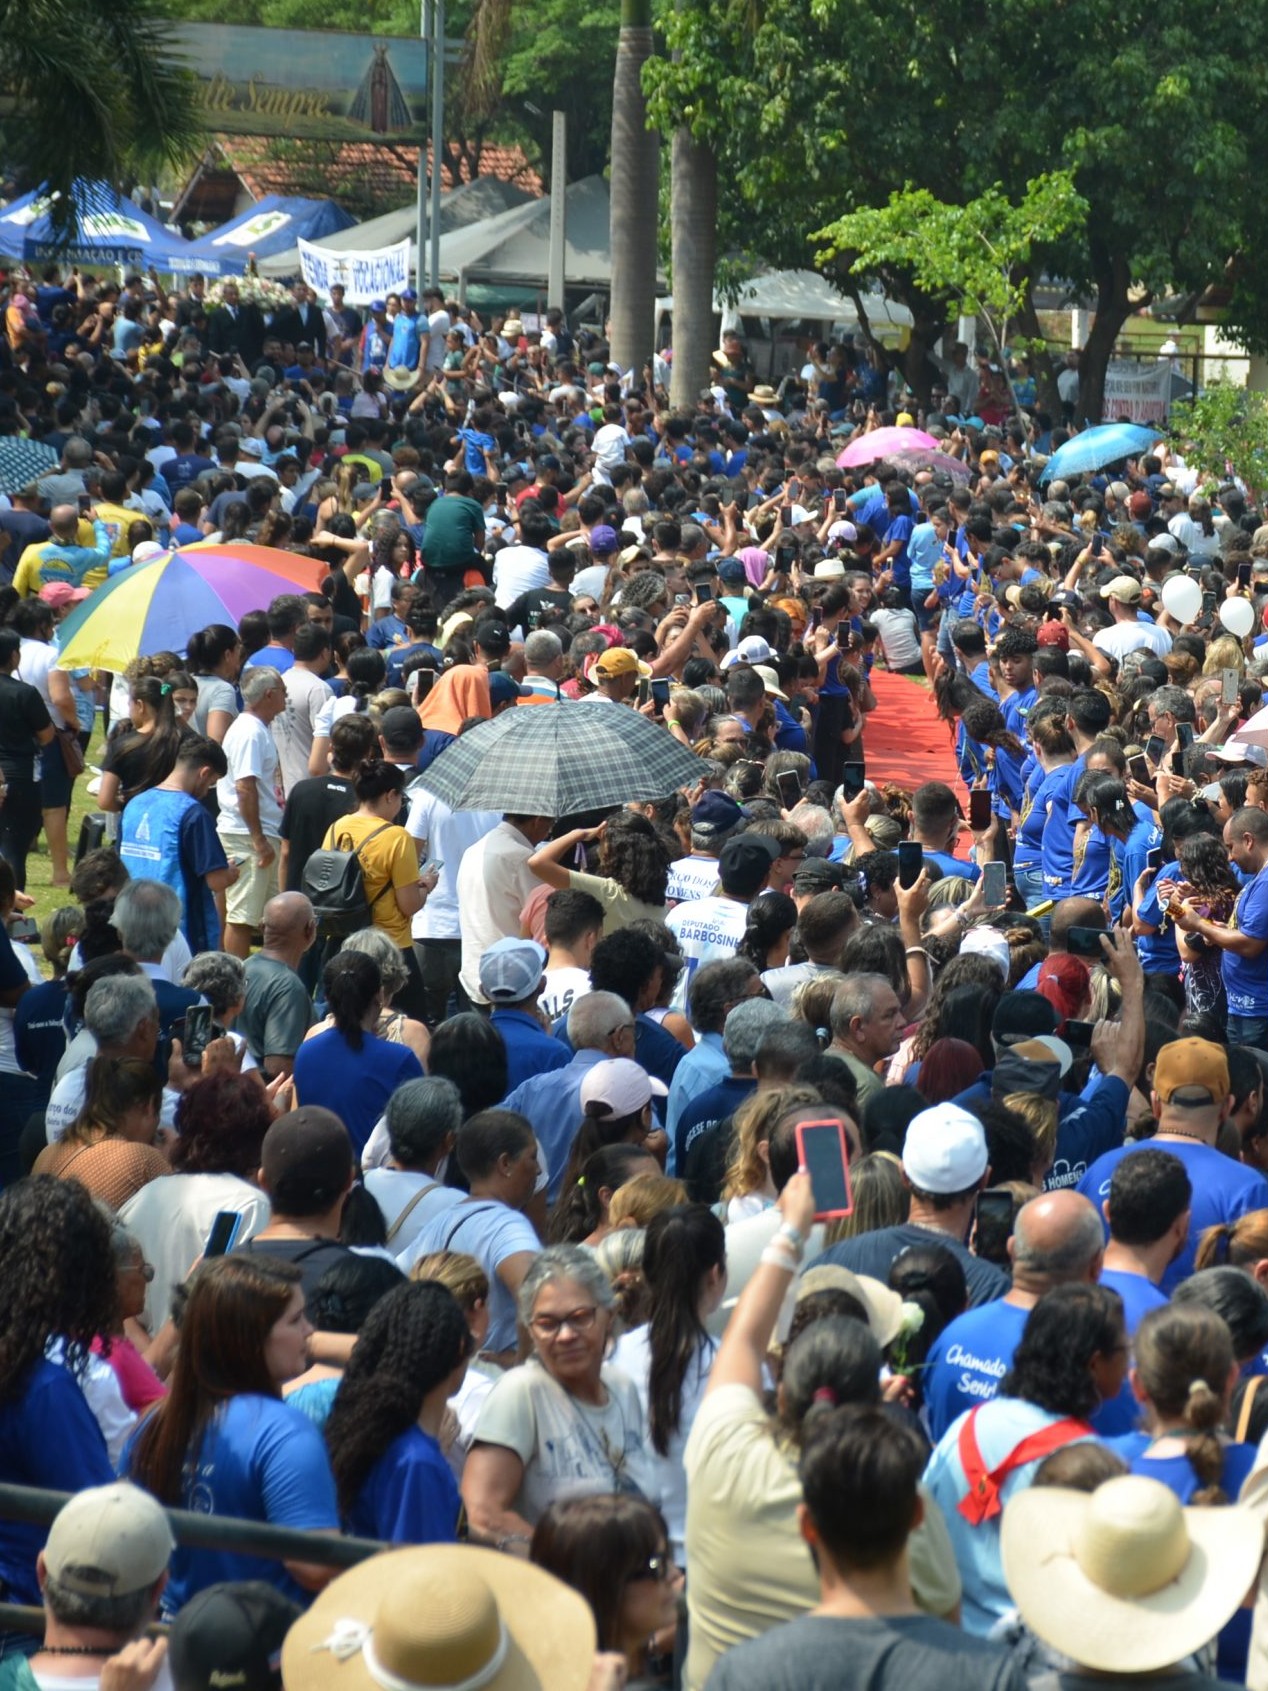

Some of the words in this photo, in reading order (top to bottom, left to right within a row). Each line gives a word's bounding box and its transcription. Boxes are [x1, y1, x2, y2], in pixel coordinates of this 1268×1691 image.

[667, 885, 701, 900] OMENS
[682, 919, 720, 932] DEPUTADO
[680, 927, 741, 949] BARBOSINH
[1048, 1169, 1084, 1191] HOMENS
[945, 1343, 1007, 1379] Chamado
